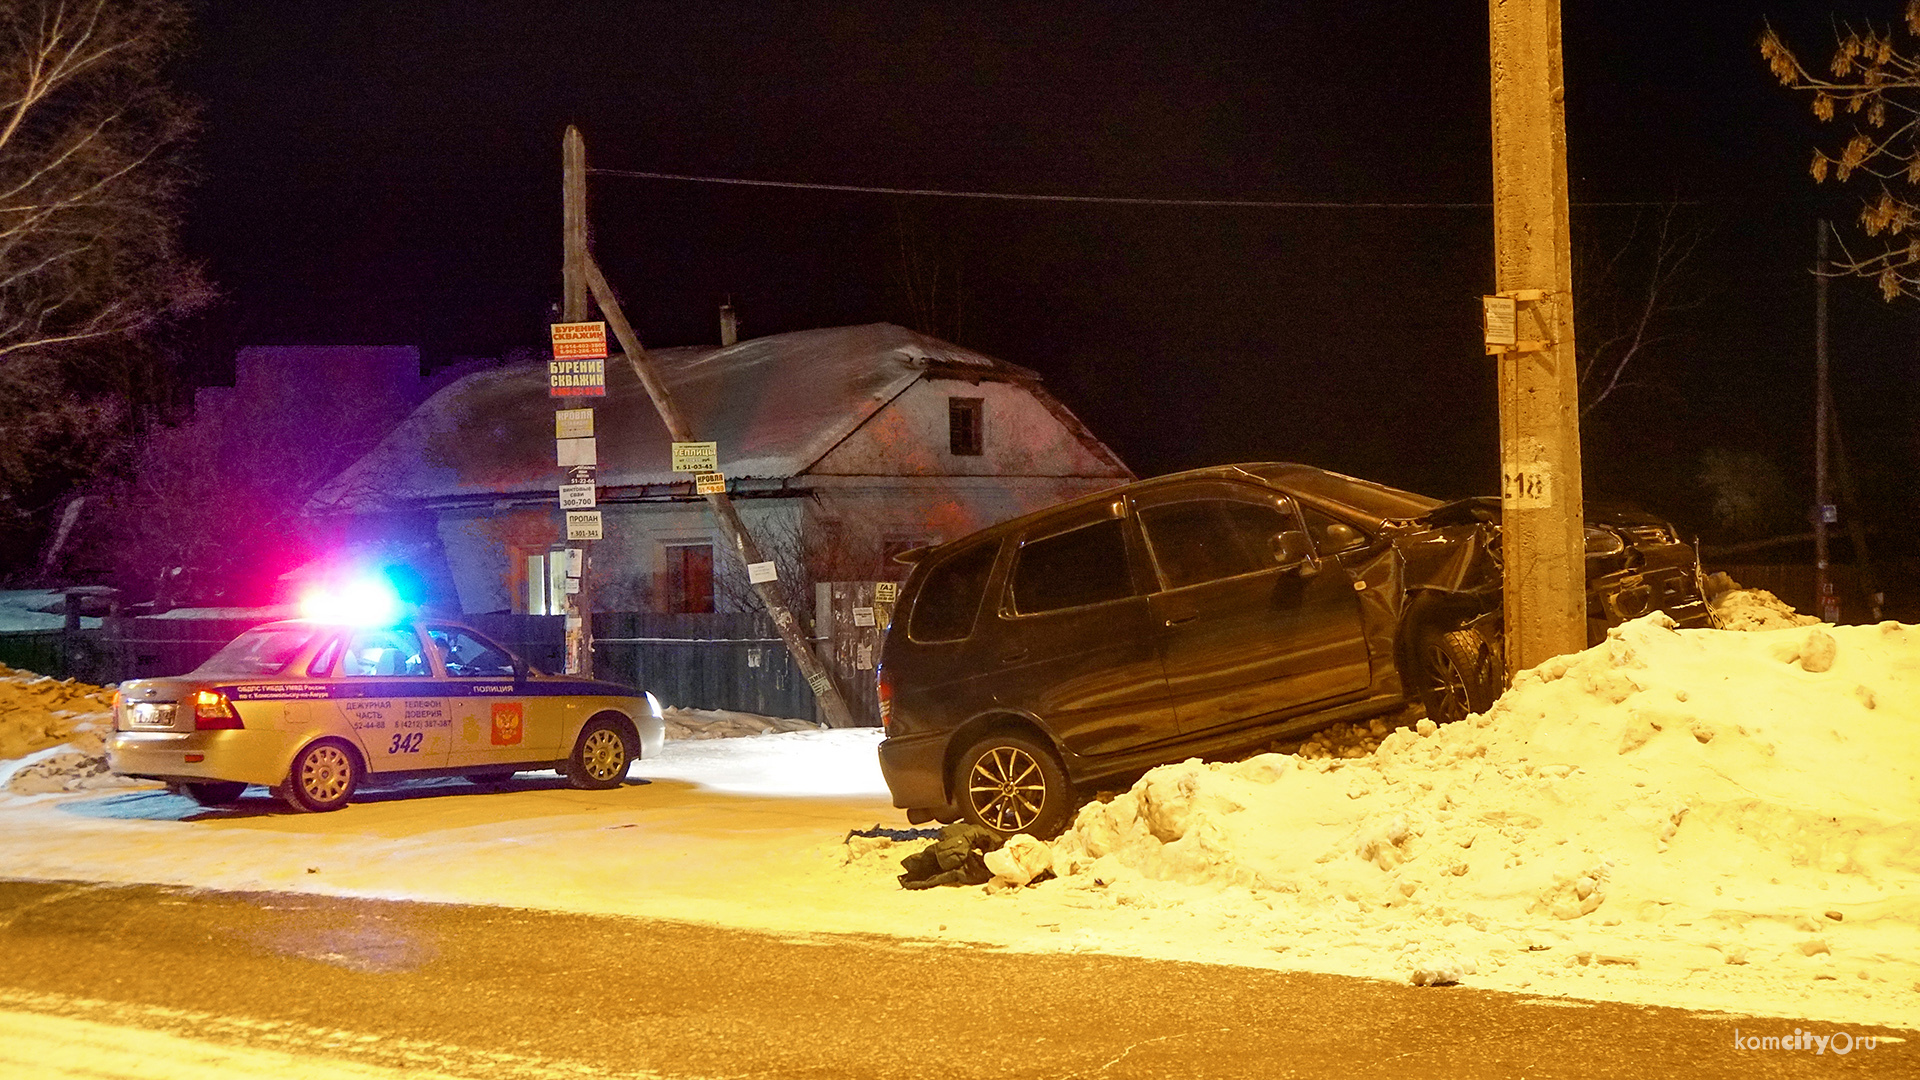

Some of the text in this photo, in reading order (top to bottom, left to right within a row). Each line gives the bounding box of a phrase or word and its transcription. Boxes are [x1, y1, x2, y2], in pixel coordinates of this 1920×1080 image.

[555, 325, 601, 333] БУРЕНИЕ
[553, 332, 603, 340] СКВАЖИН
[550, 361, 602, 374] БУРЕНИЕ
[550, 374, 604, 387] СКВАЖИН
[557, 411, 592, 420] КРОВЛЯ
[674, 449, 716, 457] ТЕПЛИЦЫ
[697, 475, 723, 483] КРОВЛЯ
[473, 685, 514, 693] ПОЛИЦИЯ
[346, 701, 391, 710] ДЕЖУРНАЯ
[356, 711, 382, 719] ЧАСТЬ
[405, 710, 442, 719] ДОВЕРИЯ
[388, 732, 424, 754] 342
